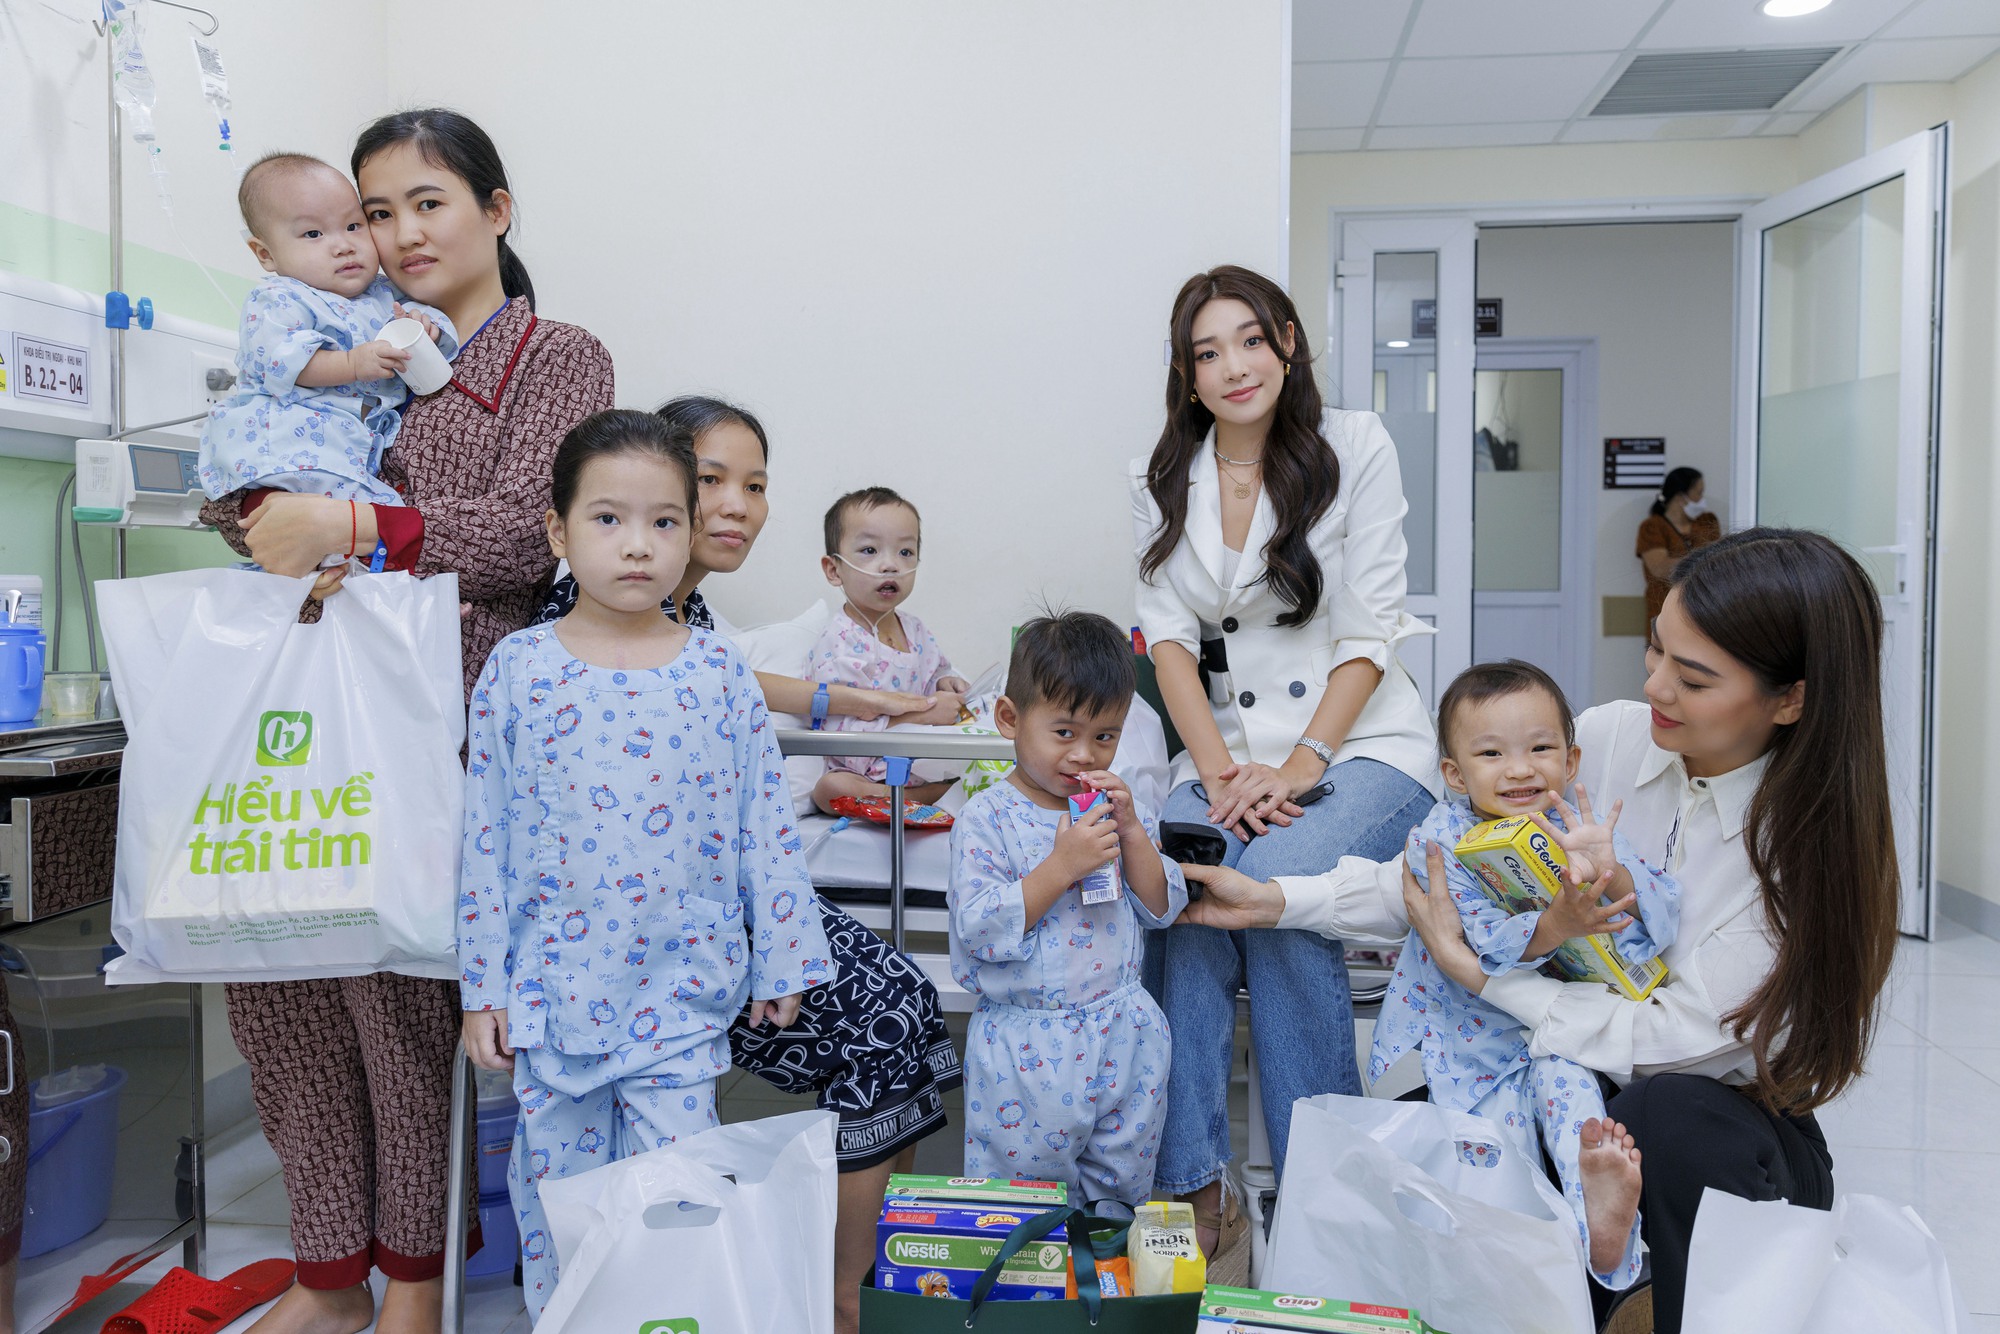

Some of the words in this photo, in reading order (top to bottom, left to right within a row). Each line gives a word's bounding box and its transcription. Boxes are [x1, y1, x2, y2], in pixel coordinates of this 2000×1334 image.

[25, 365, 35, 387] B.
[40, 367, 56, 390] 2.2
[70, 373, 82, 395] 04
[595, 760, 612, 768] Beep
[602, 764, 622, 772] Beep
[193, 775, 301, 824] Hiểu
[310, 772, 375, 819] về
[188, 829, 273, 874] trái
[280, 828, 371, 870] tim
[598, 972, 614, 981] Beep
[604, 978, 624, 986] Beep
[851, 982, 886, 1015] VIP
[840, 1118, 898, 1150] CHRISTIAN
[900, 1102, 922, 1130] DIOR
[977, 1215, 1020, 1226] STARS
[1145, 1235, 1190, 1247] BON!
[895, 1241, 951, 1260] Nestlé
[980, 1246, 1000, 1256] Who
[1279, 1298, 1318, 1307] MILO
